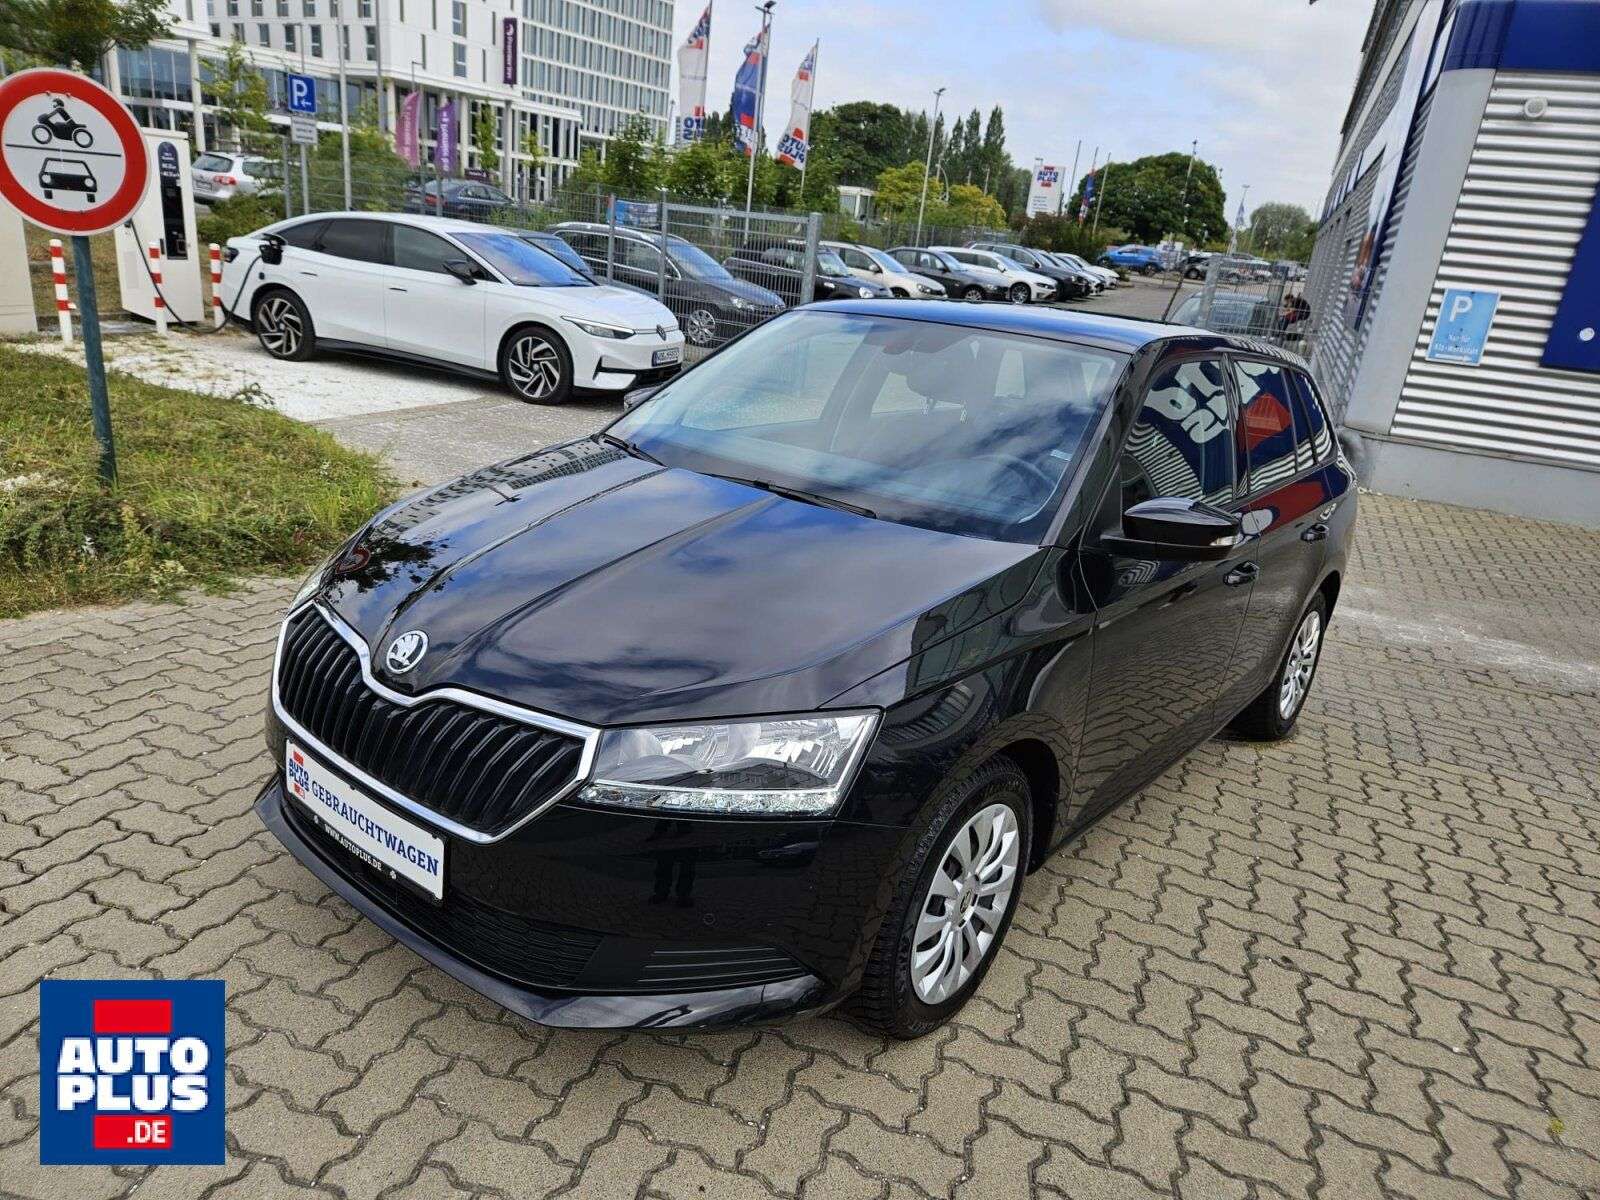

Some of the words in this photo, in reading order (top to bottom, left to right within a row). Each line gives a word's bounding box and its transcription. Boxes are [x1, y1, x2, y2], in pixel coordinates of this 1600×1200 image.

[291, 79, 308, 106] P
[1449, 296, 1473, 323] P
[289, 758, 309, 781] AUTO
[289, 768, 310, 792] PLUS
[311, 780, 439, 876] GEBRAUCHTWAGEN
